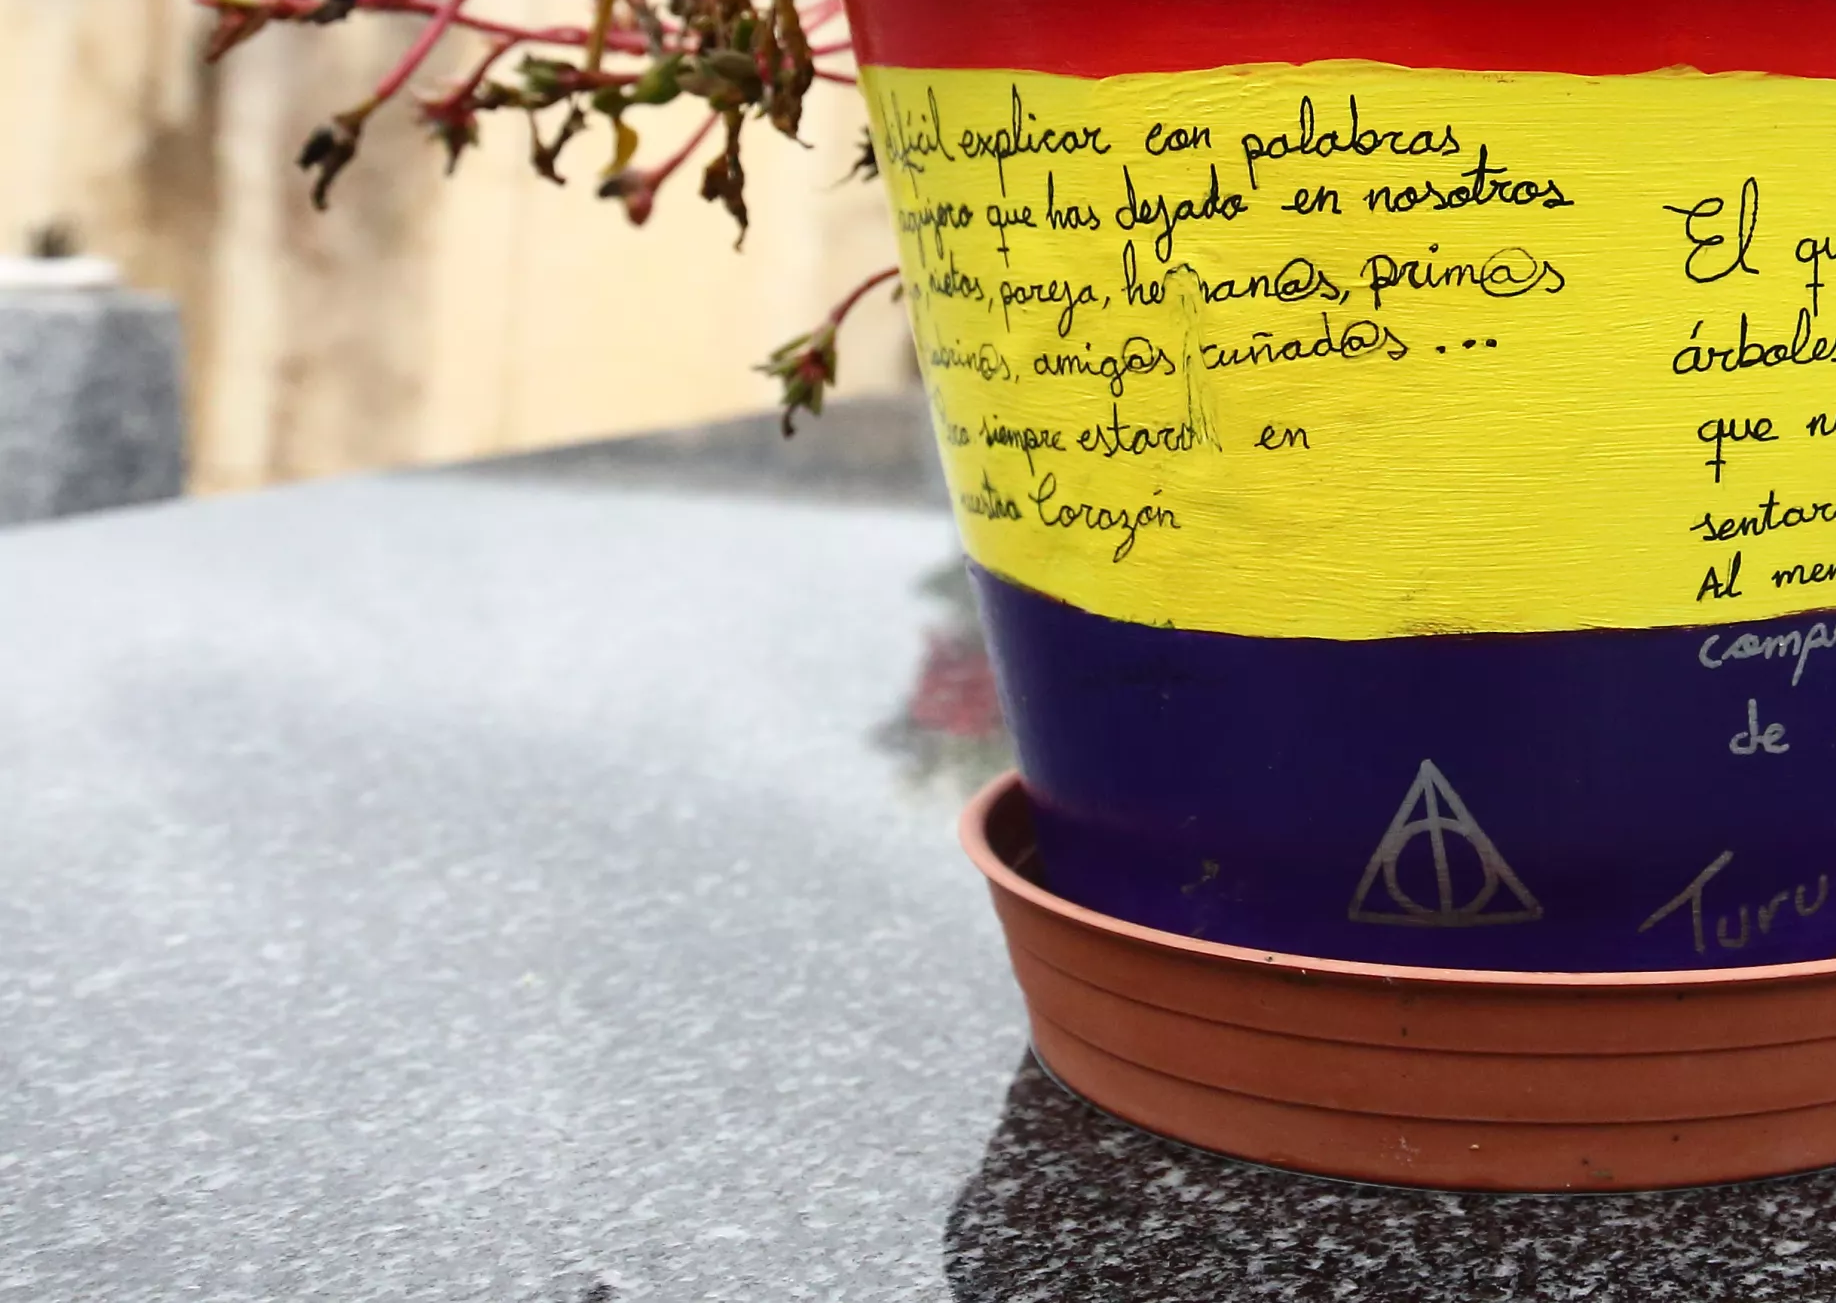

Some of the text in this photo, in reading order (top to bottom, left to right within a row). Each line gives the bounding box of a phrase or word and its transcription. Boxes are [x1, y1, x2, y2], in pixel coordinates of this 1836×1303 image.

[958, 84, 1112, 198] explicar
[1145, 121, 1212, 154] con
[1240, 95, 1461, 190] palabras
[986, 204, 1038, 268] que
[1046, 170, 1101, 231] has
[1115, 163, 1248, 263] dejado
[1280, 184, 1341, 216] en
[1364, 143, 1574, 216] nosotros
[1662, 176, 1760, 284] El
[1360, 243, 1566, 311] prim@s
[979, 414, 1067, 476] siempre
[1253, 423, 1311, 452] en
[1696, 417, 1780, 484] que
[1695, 551, 1743, 603] Al
[1728, 698, 1789, 755] de
